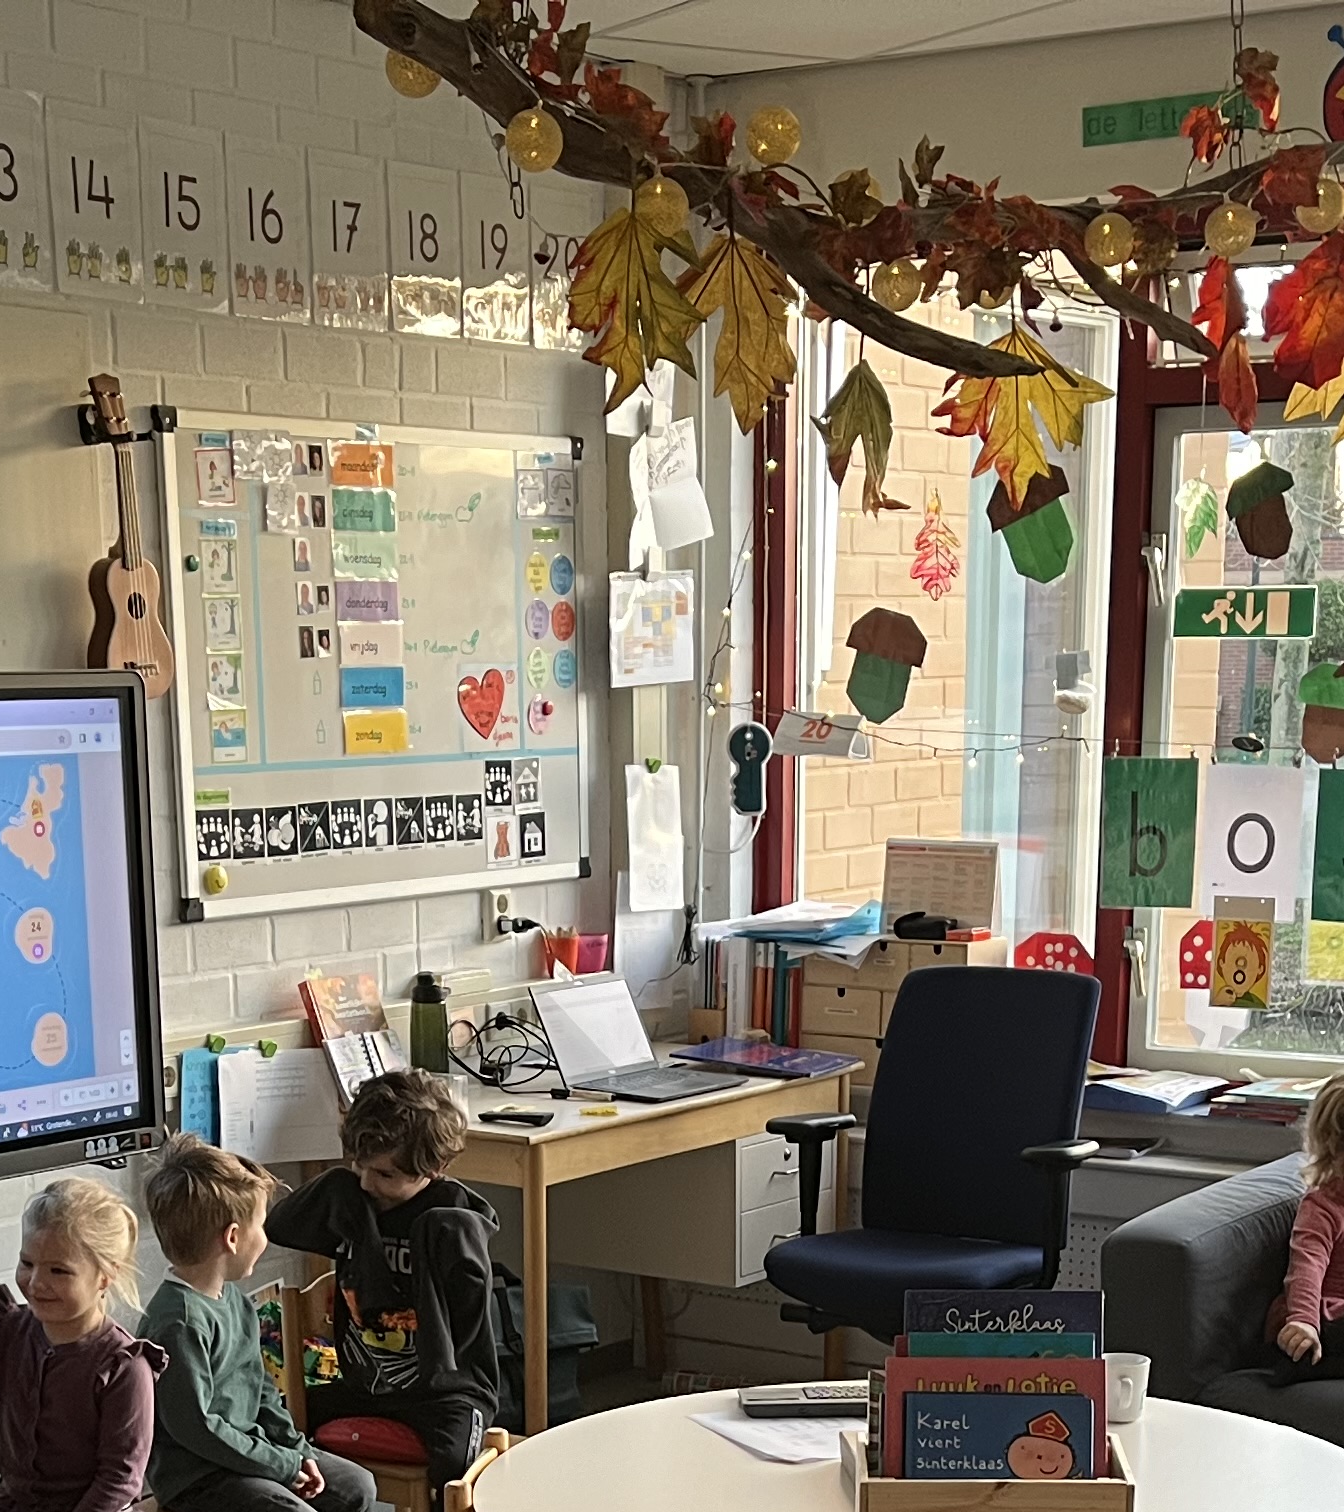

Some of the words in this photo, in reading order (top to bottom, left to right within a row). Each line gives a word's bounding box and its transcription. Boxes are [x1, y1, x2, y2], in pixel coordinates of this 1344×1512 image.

[1087, 115, 1117, 136] de
[71, 156, 115, 220] 14
[163, 171, 202, 231] 15
[247, 187, 284, 245] 16
[331, 199, 362, 254] 17
[408, 210, 439, 263] 18
[480, 219, 509, 270] 19
[343, 553, 382, 568] woensdag
[346, 598, 389, 612] donderdag
[351, 684, 387, 697] zaterdag
[355, 729, 383, 743] zondag
[800, 719, 834, 739] 20
[943, 1304, 1066, 1334] Sinterklaas
[916, 1410, 970, 1430] Karel
[917, 1436, 961, 1450] viert
[916, 1455, 1004, 1471] sinterklaas
